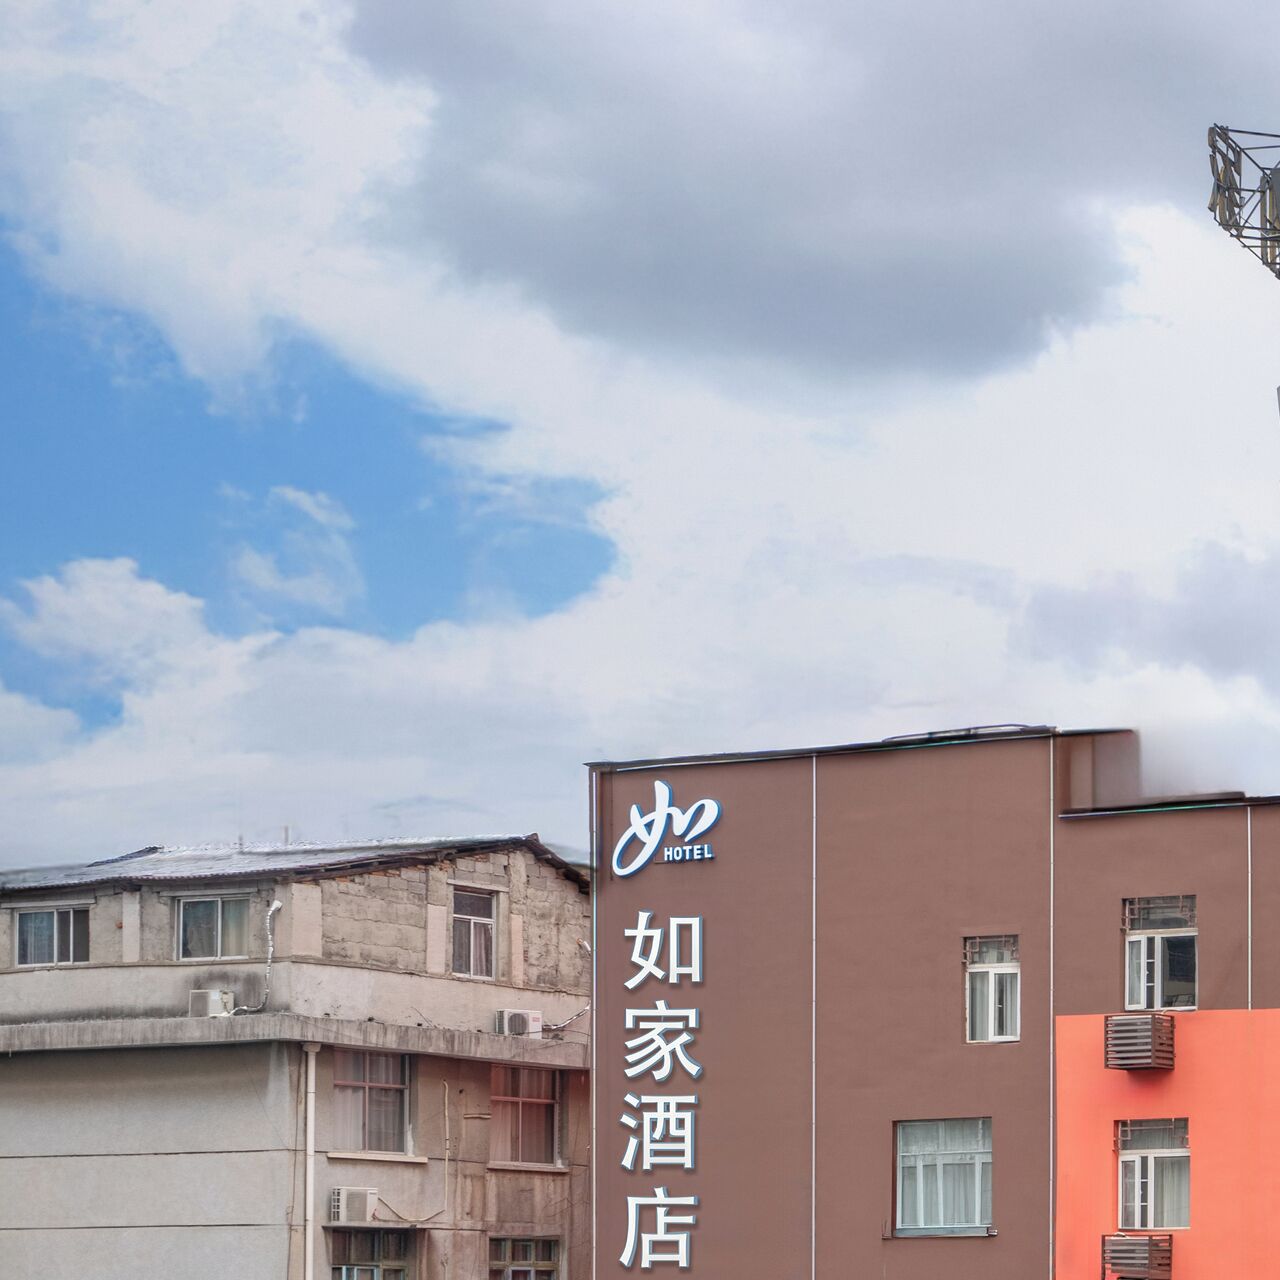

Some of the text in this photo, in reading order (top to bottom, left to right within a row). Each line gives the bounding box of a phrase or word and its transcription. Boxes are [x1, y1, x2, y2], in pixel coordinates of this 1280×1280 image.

[664, 844, 713, 861] HOTEL
[619, 911, 703, 1270] 如家酒店
